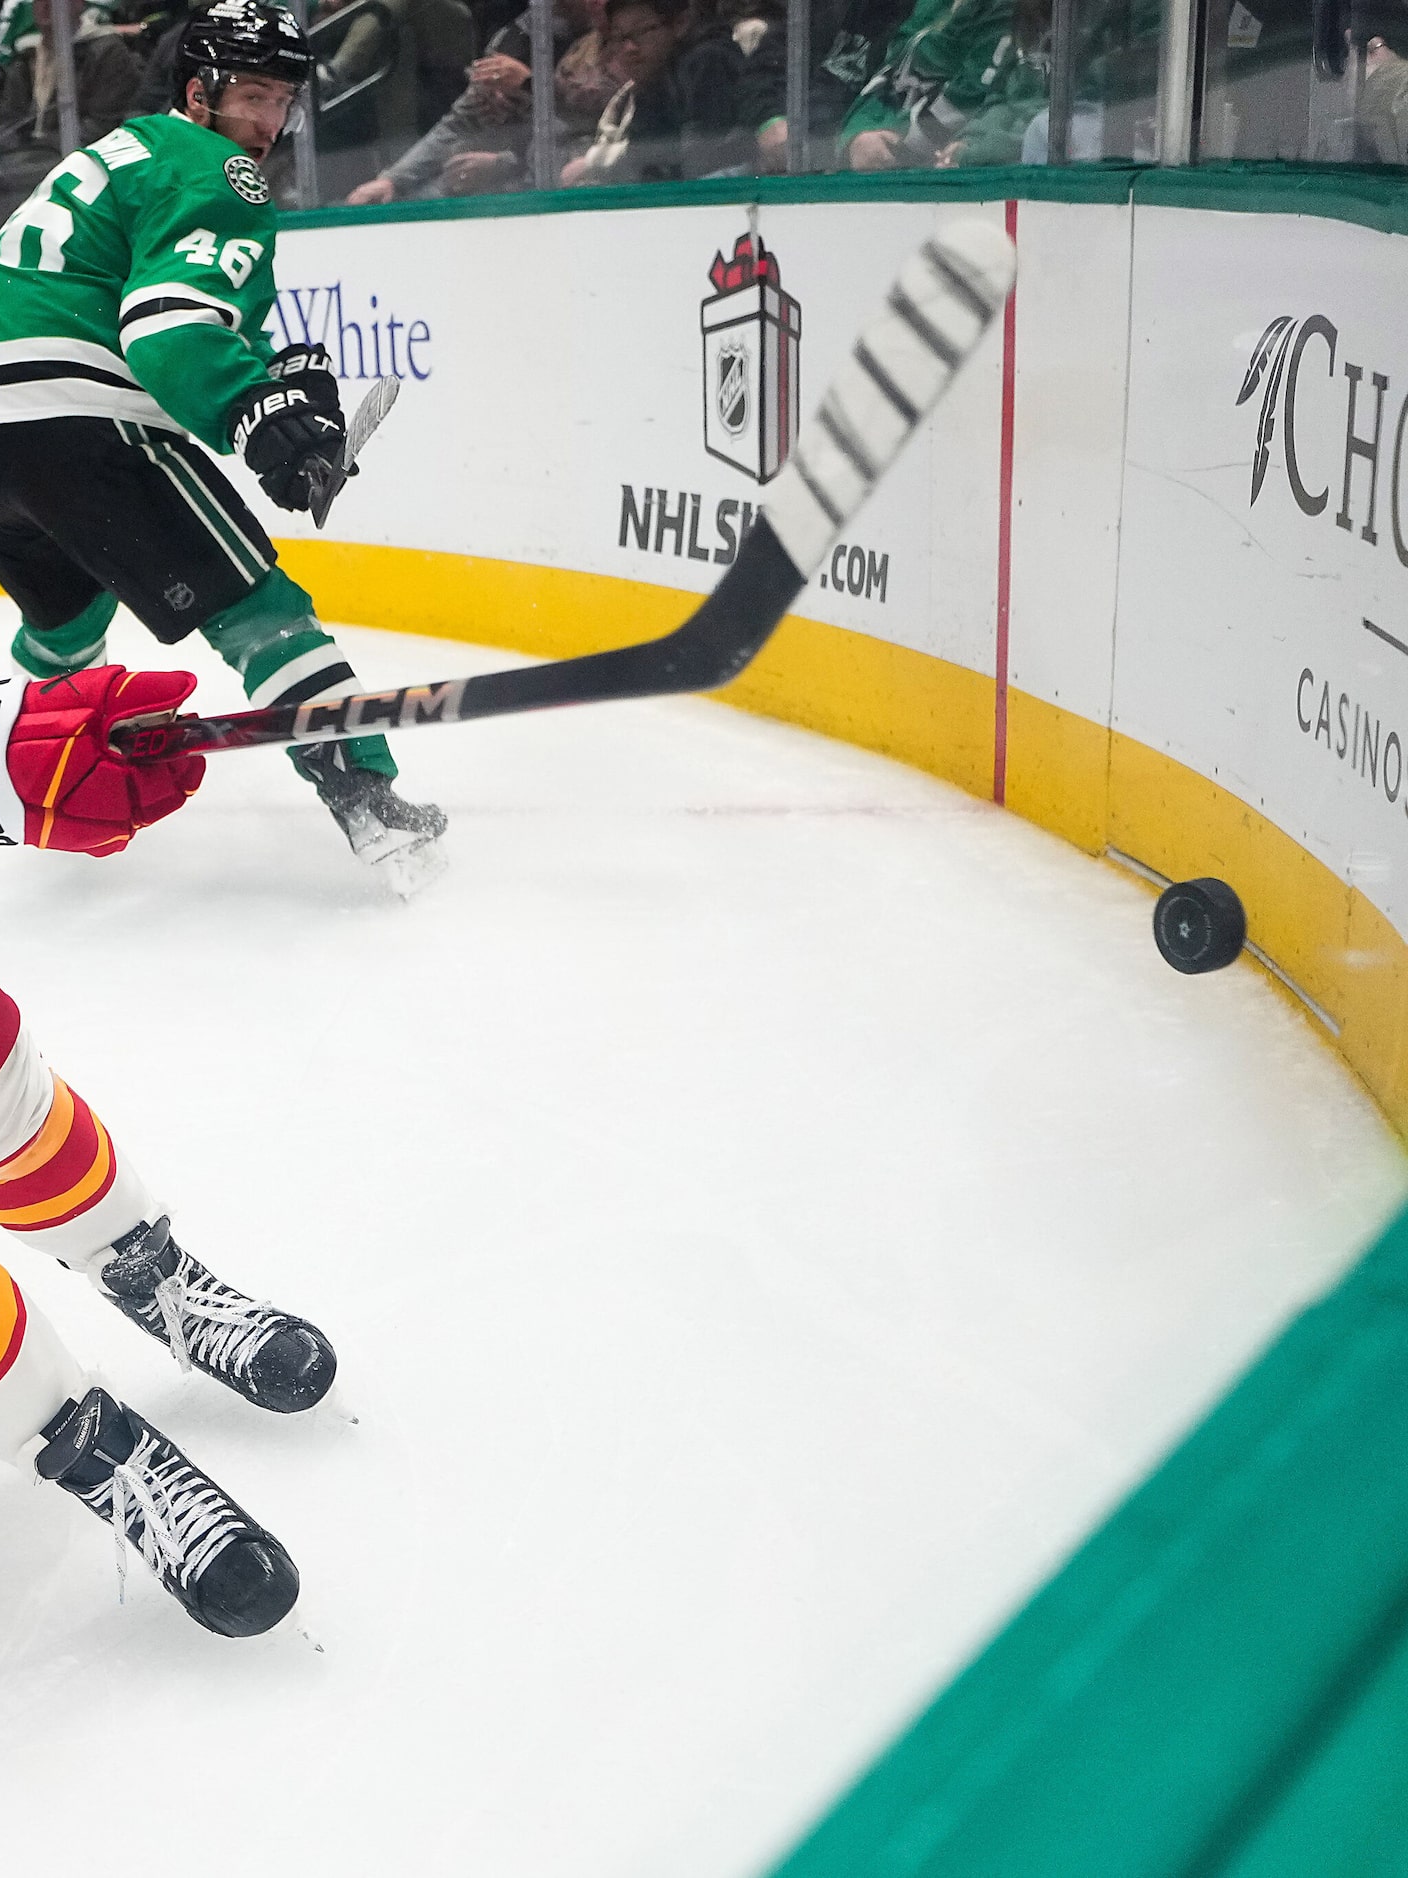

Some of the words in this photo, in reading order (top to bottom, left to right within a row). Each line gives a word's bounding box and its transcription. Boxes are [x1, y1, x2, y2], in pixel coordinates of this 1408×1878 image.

[174, 228, 264, 289] 46
[276, 281, 433, 380] White
[618, 484, 890, 604] NHLS.COM
[293, 678, 466, 737] CCM
